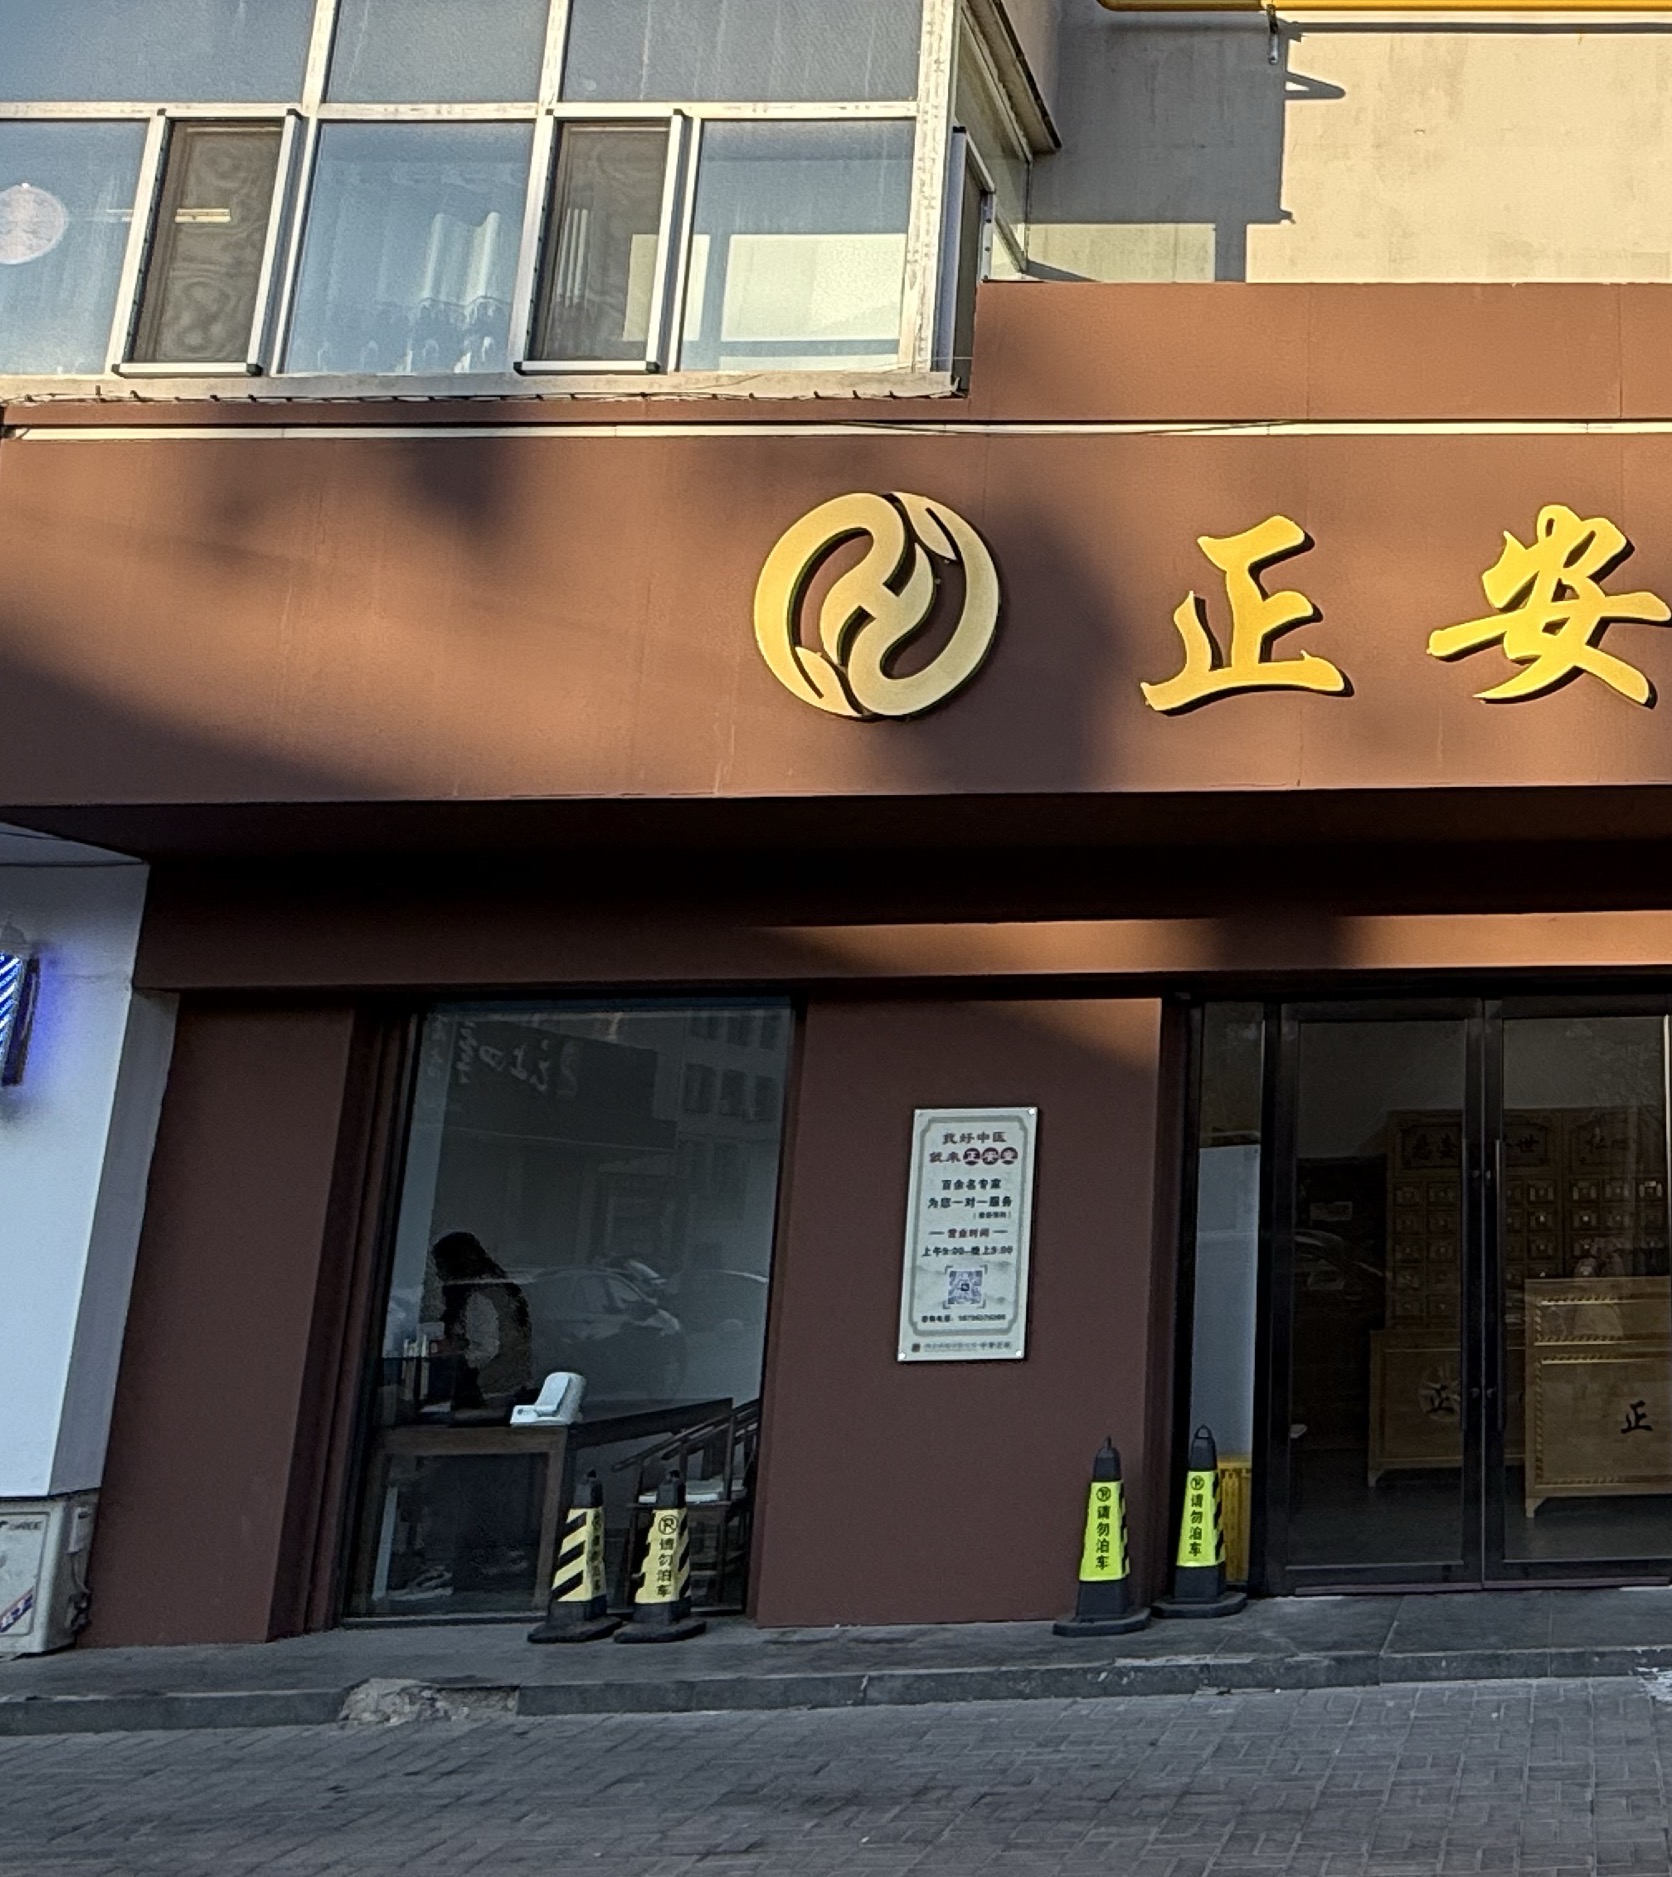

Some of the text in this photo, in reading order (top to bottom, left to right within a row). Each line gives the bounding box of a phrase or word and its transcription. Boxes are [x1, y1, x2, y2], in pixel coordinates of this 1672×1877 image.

[1619, 1398, 1654, 1435] 正
[1095, 1504, 1111, 1571] 请勿泊车
